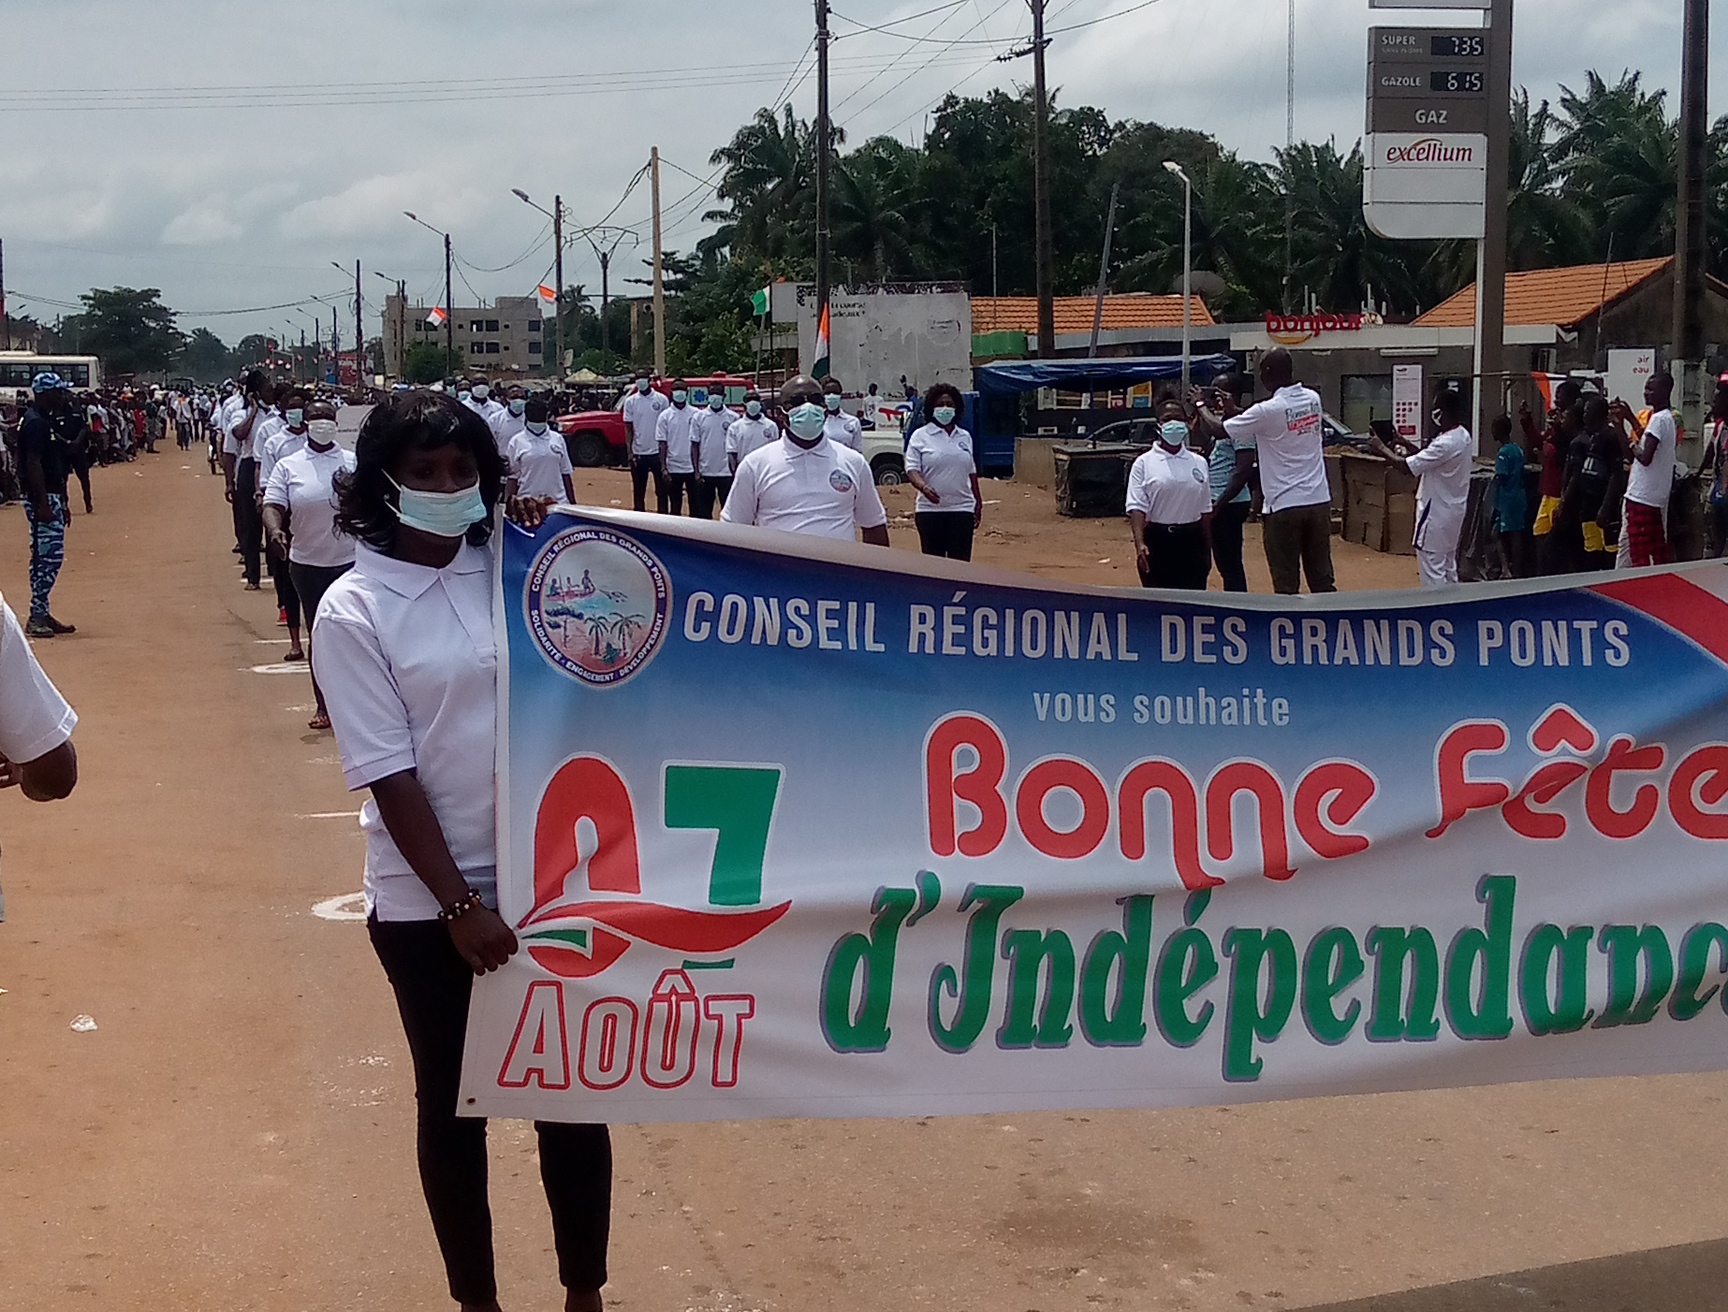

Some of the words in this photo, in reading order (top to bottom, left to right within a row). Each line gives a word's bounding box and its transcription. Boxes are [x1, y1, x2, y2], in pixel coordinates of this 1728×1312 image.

[1381, 35, 1416, 45] SUPER
[1451, 37, 1482, 55] 735
[1381, 76, 1422, 87] GAZOLE
[1447, 73, 1481, 90] 615
[1415, 109, 1448, 124] GAZ
[1386, 141, 1473, 162] excellium
[1637, 355, 1650, 364] air
[531, 547, 555, 593] CONSEIL
[554, 531, 598, 553] RÉGIONAL
[599, 532, 617, 543] DES
[618, 538, 652, 567] GRANDS
[650, 566, 666, 599] PONTS
[531, 609, 561, 663] SOLIDARITÉ
[566, 661, 615, 682] ENGAGEMENT
[619, 613, 664, 677] DÉVELOPPEMENT
[684, 591, 886, 653] CONSEIL
[908, 591, 1139, 661] RÉGIONAL
[1161, 614, 1248, 665] DES
[1270, 617, 1455, 667] GRANDS
[1478, 619, 1631, 668] PONTS
[1033, 692, 1116, 724] vous
[1133, 687, 1290, 726] souhaite
[925, 711, 1378, 889] Bonne
[532, 754, 784, 978] 07
[819, 871, 1728, 1083] d'Indépendanc
[497, 968, 756, 1091] AOÛT
